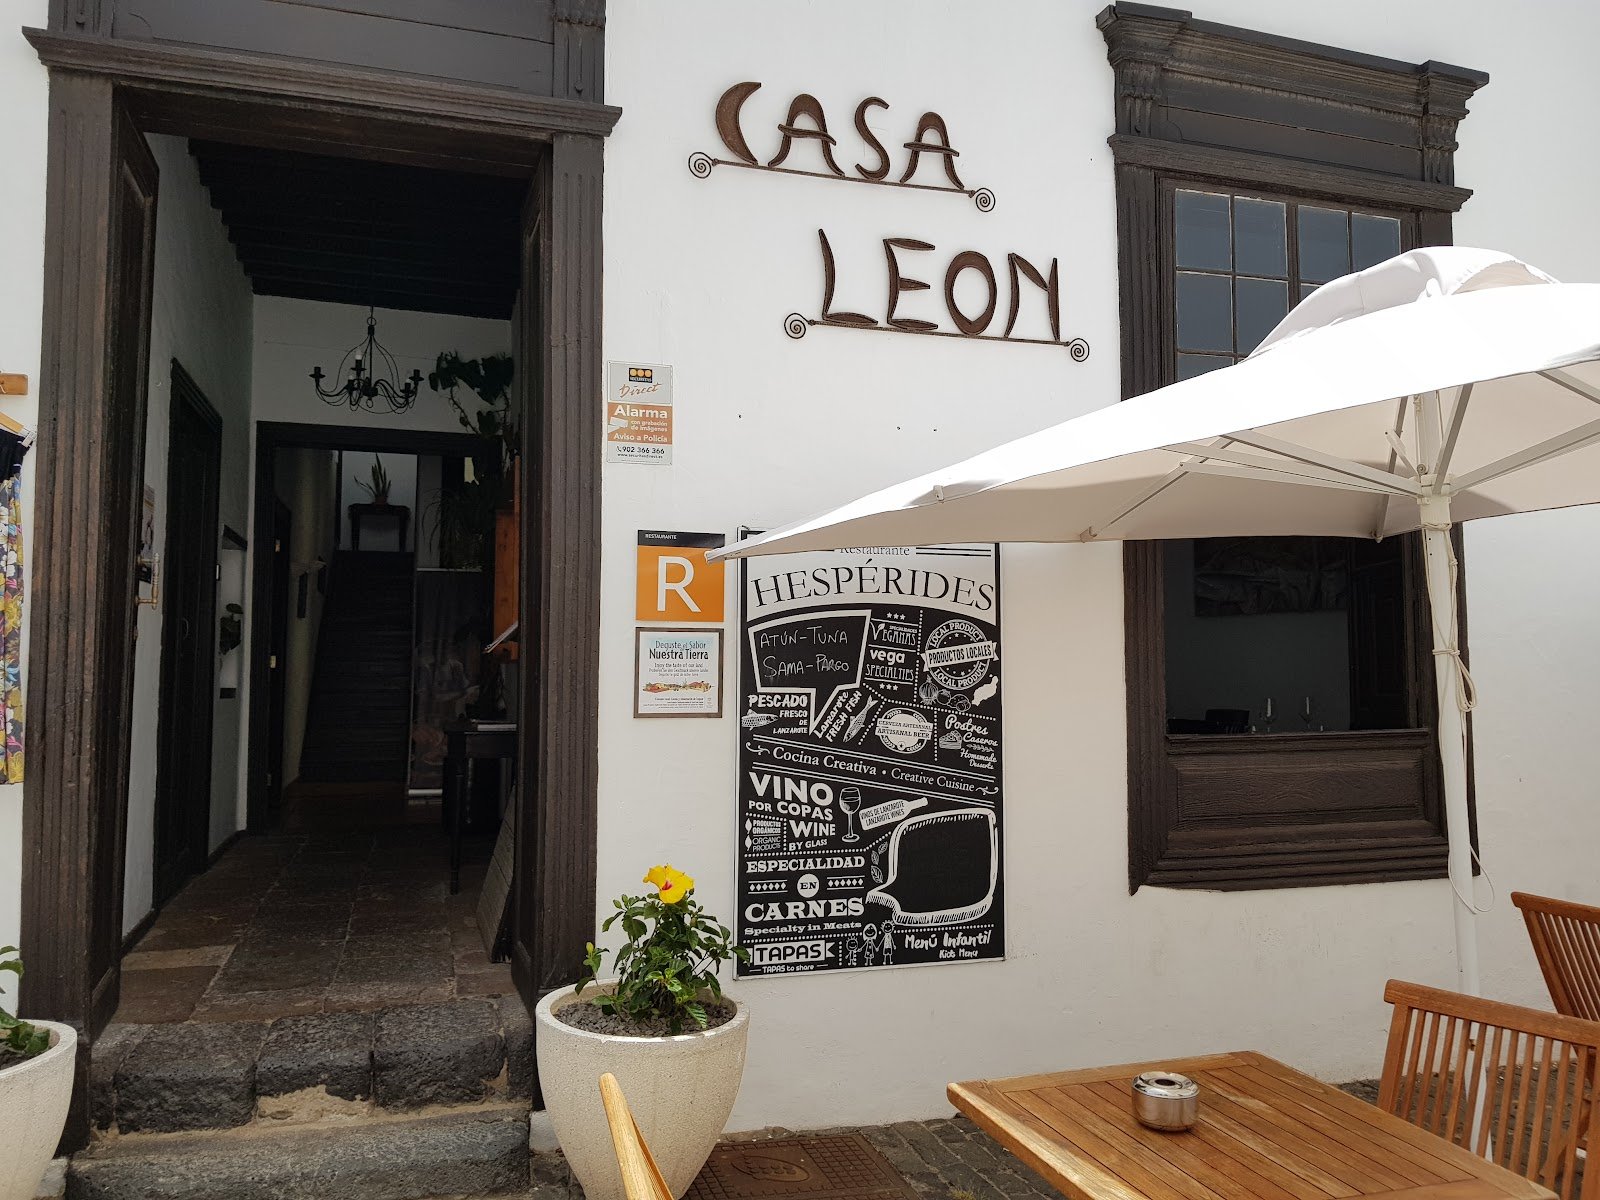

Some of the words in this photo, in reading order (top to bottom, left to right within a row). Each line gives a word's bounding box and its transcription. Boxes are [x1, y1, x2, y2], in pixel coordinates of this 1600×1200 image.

[715, 81, 965, 190] CASA
[818, 228, 1060, 342] LEON
[619, 382, 661, 398] Direct
[614, 404, 668, 419] Alarma
[643, 434, 668, 443] Policía
[657, 555, 701, 613] R
[750, 558, 994, 611] HESPÉRIDES
[929, 625, 950, 648] LOCAL
[950, 622, 983, 641] PRODUCT
[649, 648, 684, 660] Nuestra
[685, 648, 709, 660] Tierra
[655, 640, 682, 651] Deguste
[689, 641, 706, 649] Sabor
[928, 648, 964, 665] PRODUCTOS
[966, 644, 991, 659] LOCALES
[870, 649, 906, 666] vega
[865, 663, 914, 681] SPECIALTIES
[933, 669, 957, 687] LOCAL
[957, 661, 986, 688] PRODUCT
[747, 694, 808, 708] PESCADO
[779, 710, 808, 718] FRESCO
[813, 690, 849, 739] Lanzarote
[825, 711, 848, 743] FRESH
[845, 690, 862, 712] FISH
[945, 714, 989, 735] Postres
[912, 730, 931, 738] BEER
[772, 746, 820, 766] Cocina
[823, 755, 877, 776] Creativa
[891, 767, 935, 786] Creative
[936, 776, 975, 793] Cuisine
[748, 771, 834, 807] VINO
[748, 800, 772, 813] POR
[776, 801, 833, 821] COPAS
[873, 807, 880, 816] DE
[788, 819, 836, 839] WINE
[752, 836, 781, 845] ORGANIC
[789, 841, 803, 851] BY
[805, 838, 828, 849] GLASS
[746, 856, 865, 874] ESPECIALIDAD
[800, 881, 818, 890] EN
[744, 897, 865, 923] CARNES
[744, 924, 807, 937] Specialty
[807, 922, 821, 932] in
[823, 921, 862, 930] Meats
[943, 930, 992, 948] Infantil
[755, 943, 822, 963] TAPAS
[939, 949, 956, 959] Kids
[762, 965, 786, 973] TAPAS
[795, 963, 815, 971] share
